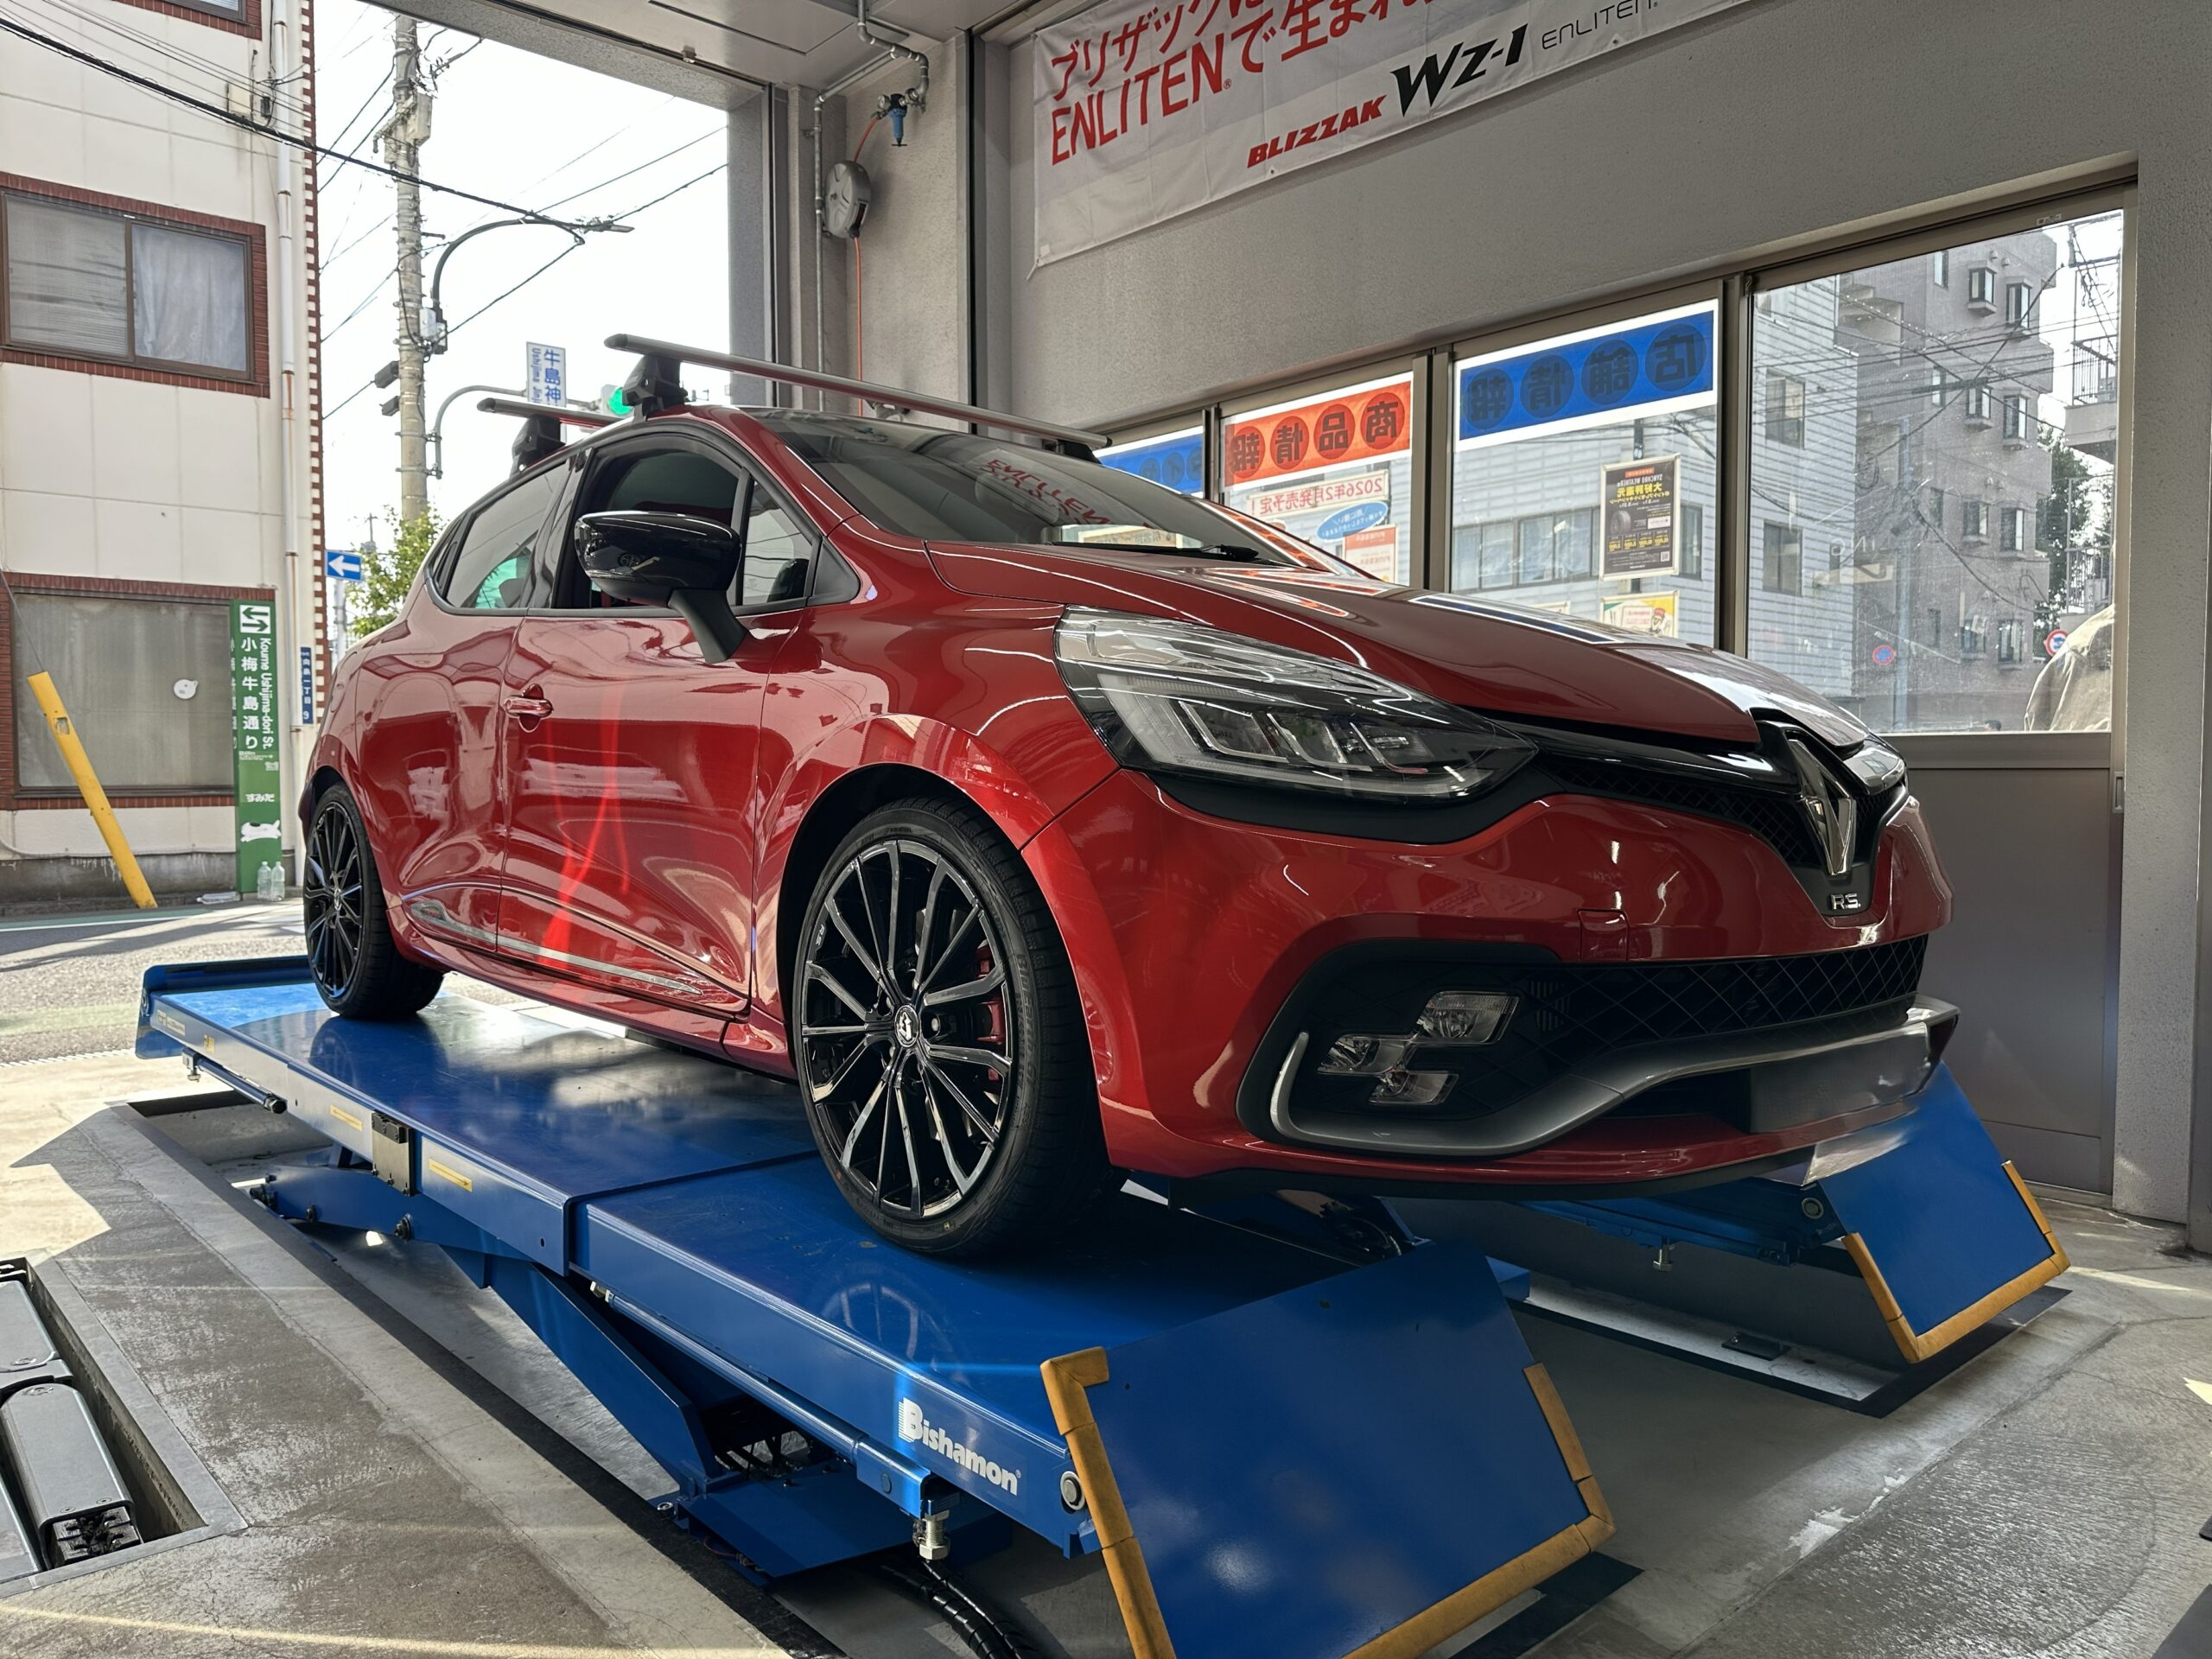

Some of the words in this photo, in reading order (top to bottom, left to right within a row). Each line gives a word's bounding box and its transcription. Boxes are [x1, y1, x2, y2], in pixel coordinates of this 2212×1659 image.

[1247, 94, 1387, 168] BLIZZAK
[543, 349, 562, 406] 牛島神
[259, 638, 271, 671] Koume
[240, 637, 260, 750] 小梅牛島通り
[259, 673, 274, 734] Ushijima-dori
[262, 736, 274, 749] St.
